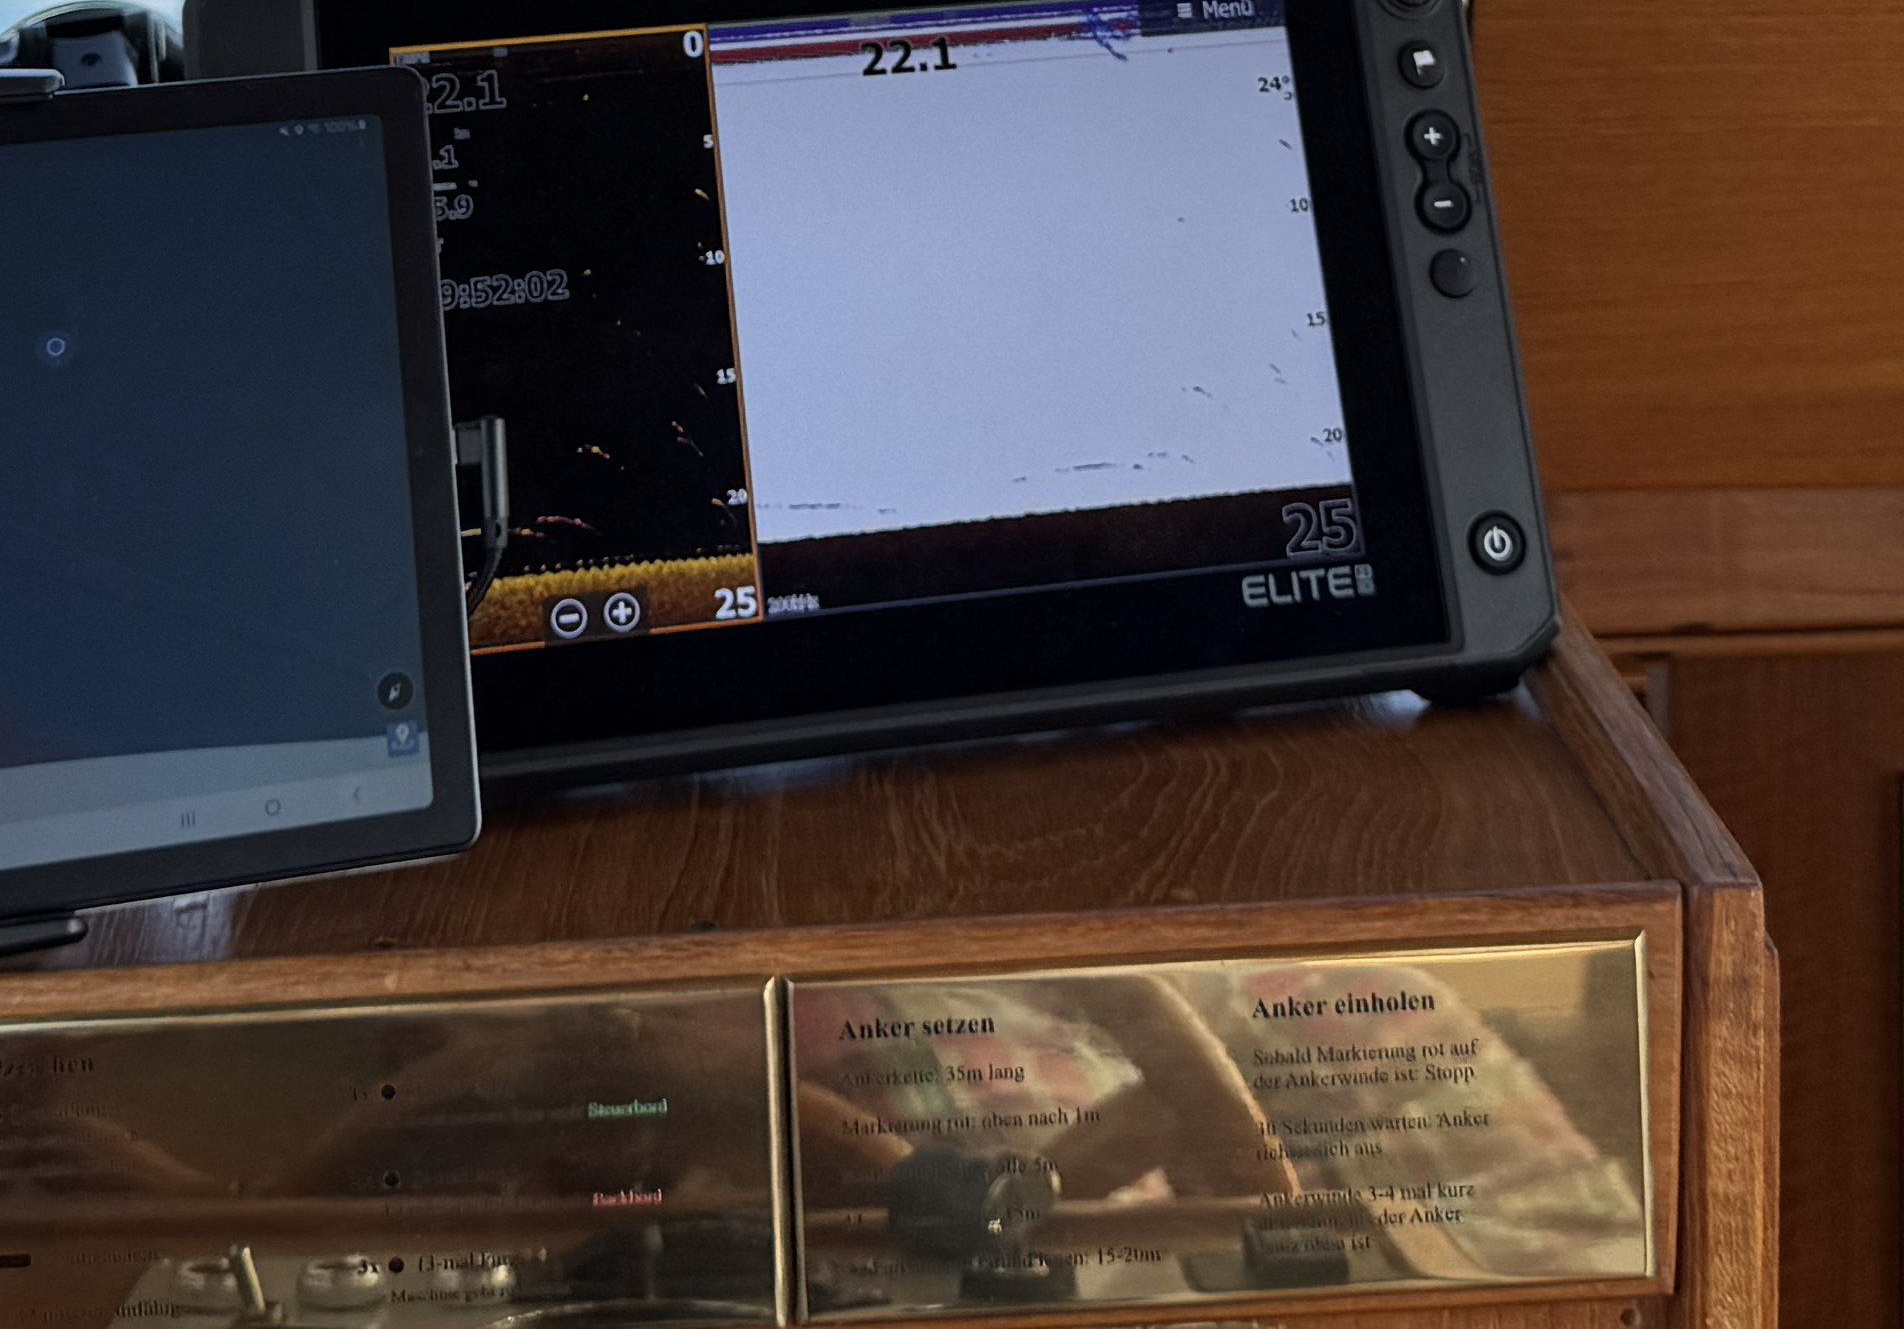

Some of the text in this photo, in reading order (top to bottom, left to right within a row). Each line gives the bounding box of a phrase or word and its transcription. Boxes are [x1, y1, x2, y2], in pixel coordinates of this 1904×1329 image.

[683, 31, 704, 59] 0
[860, 37, 958, 77] 22.1
[422, 69, 508, 113] 2.1
[1290, 195, 1310, 214] 10
[439, 269, 572, 312] 9:52:02
[1304, 310, 1326, 329] 15
[1322, 427, 1343, 444] 20
[727, 489, 750, 506] 20
[1282, 498, 1358, 555] 25
[1241, 562, 1354, 609] ELITE
[713, 585, 757, 621] 25
[1252, 990, 1435, 1020] Anker einholen
[839, 1015, 997, 1041] Anker setzen
[1253, 1038, 1480, 1066] Sobald Markierung rot auf
[945, 1065, 984, 1083] 35m
[989, 1063, 1026, 1083] lang
[1285, 1069, 1389, 1090] Ankerwinde
[1028, 1107, 1070, 1127] nach
[1281, 1116, 1366, 1136] Sekunden
[1437, 1109, 1490, 1128] Anker
[1353, 1143, 1384, 1160] aus
[1367, 1185, 1395, 1202] 3-4
[1399, 1182, 1432, 1201] mal
[1437, 1181, 1475, 1198] kurz
[1377, 1209, 1406, 1226] der
[1409, 1205, 1464, 1224] Anker
